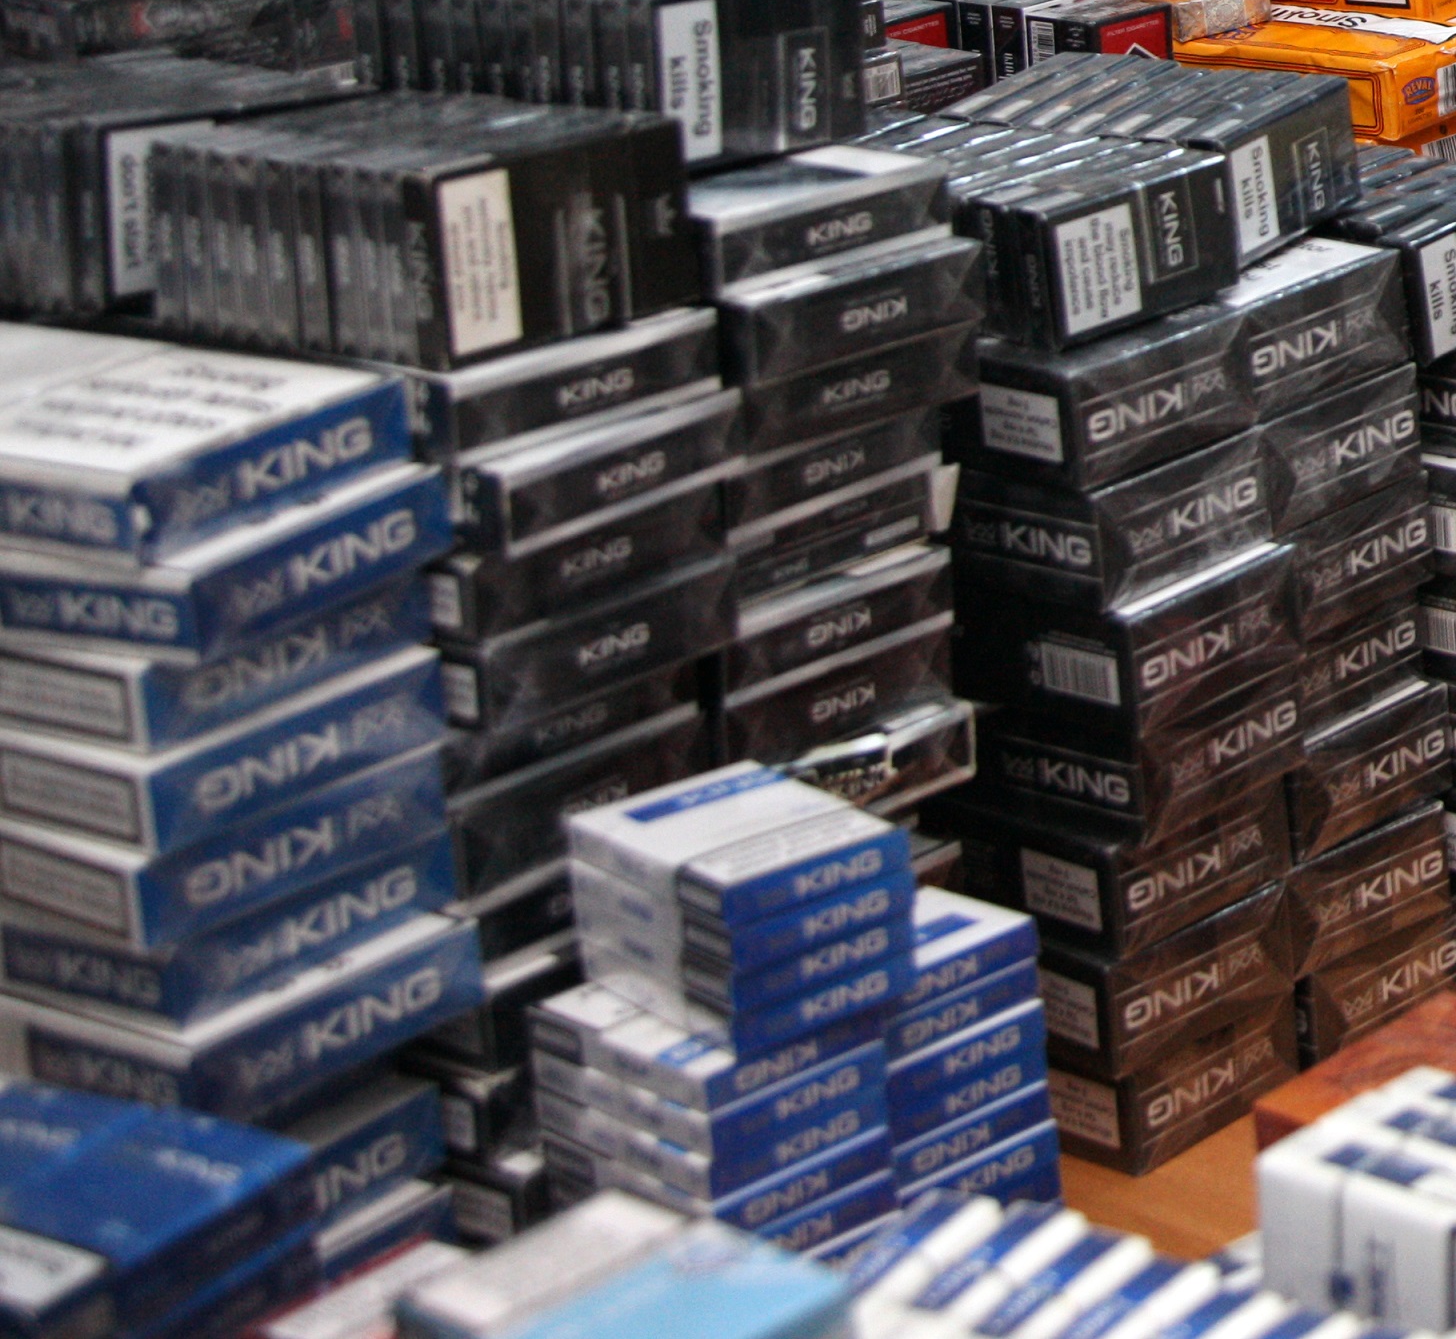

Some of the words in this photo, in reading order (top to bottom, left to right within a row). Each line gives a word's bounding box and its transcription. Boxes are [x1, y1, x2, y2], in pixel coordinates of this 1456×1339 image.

[665, 55, 688, 124] kills
[692, 20, 713, 138] Smoking
[799, 48, 817, 129] KING
[1241, 178, 1252, 219] kills
[1251, 146, 1271, 237] Smoking
[1306, 142, 1326, 210] KING
[1159, 191, 1183, 266] KING
[1429, 280, 1444, 320] kills
[1252, 321, 1338, 375] KING
[1088, 382, 1184, 443] KING
[1332, 409, 1416, 466] KING
[236, 415, 372, 499] KING
[287, 509, 415, 590] KING
[1141, 624, 1229, 690] KING
[195, 726, 339, 810] KING
[1367, 728, 1446, 790] KING
[795, 850, 882, 896] KING
[304, 967, 441, 1058] KING
[801, 970, 889, 1020] KING
[1125, 965, 1219, 1030] KING
[943, 1025, 1021, 1074] KING
[1147, 1059, 1234, 1128] KING
